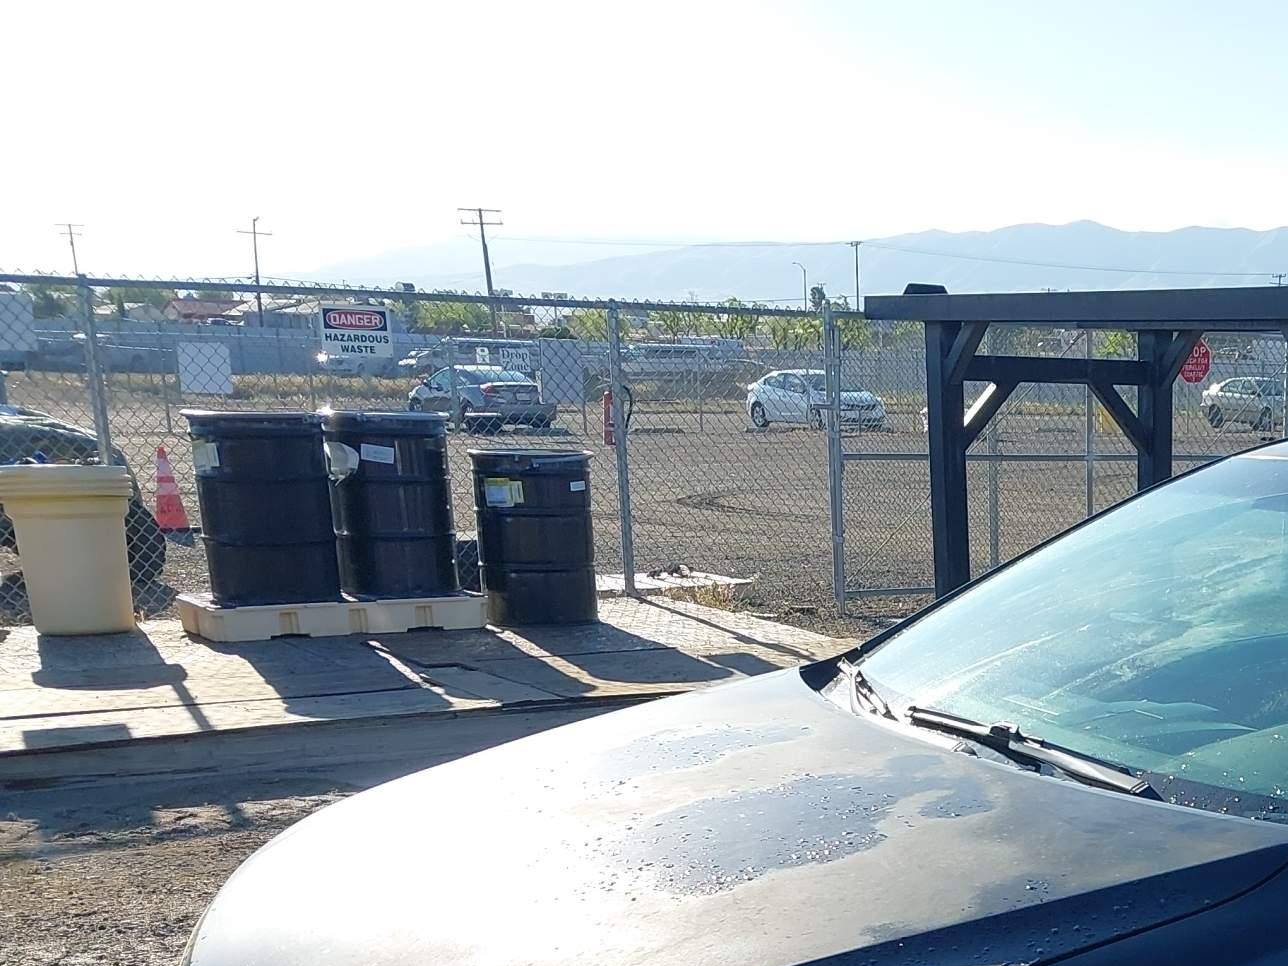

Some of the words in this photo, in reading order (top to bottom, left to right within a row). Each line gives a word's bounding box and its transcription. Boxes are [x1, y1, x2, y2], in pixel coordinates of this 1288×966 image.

[330, 313, 380, 326] DANGER
[324, 332, 389, 344] HAZARDOUS
[340, 344, 376, 354] WASTE
[1193, 346, 1206, 358] OP
[502, 349, 528, 362] Drop
[502, 360, 529, 371] Zone
